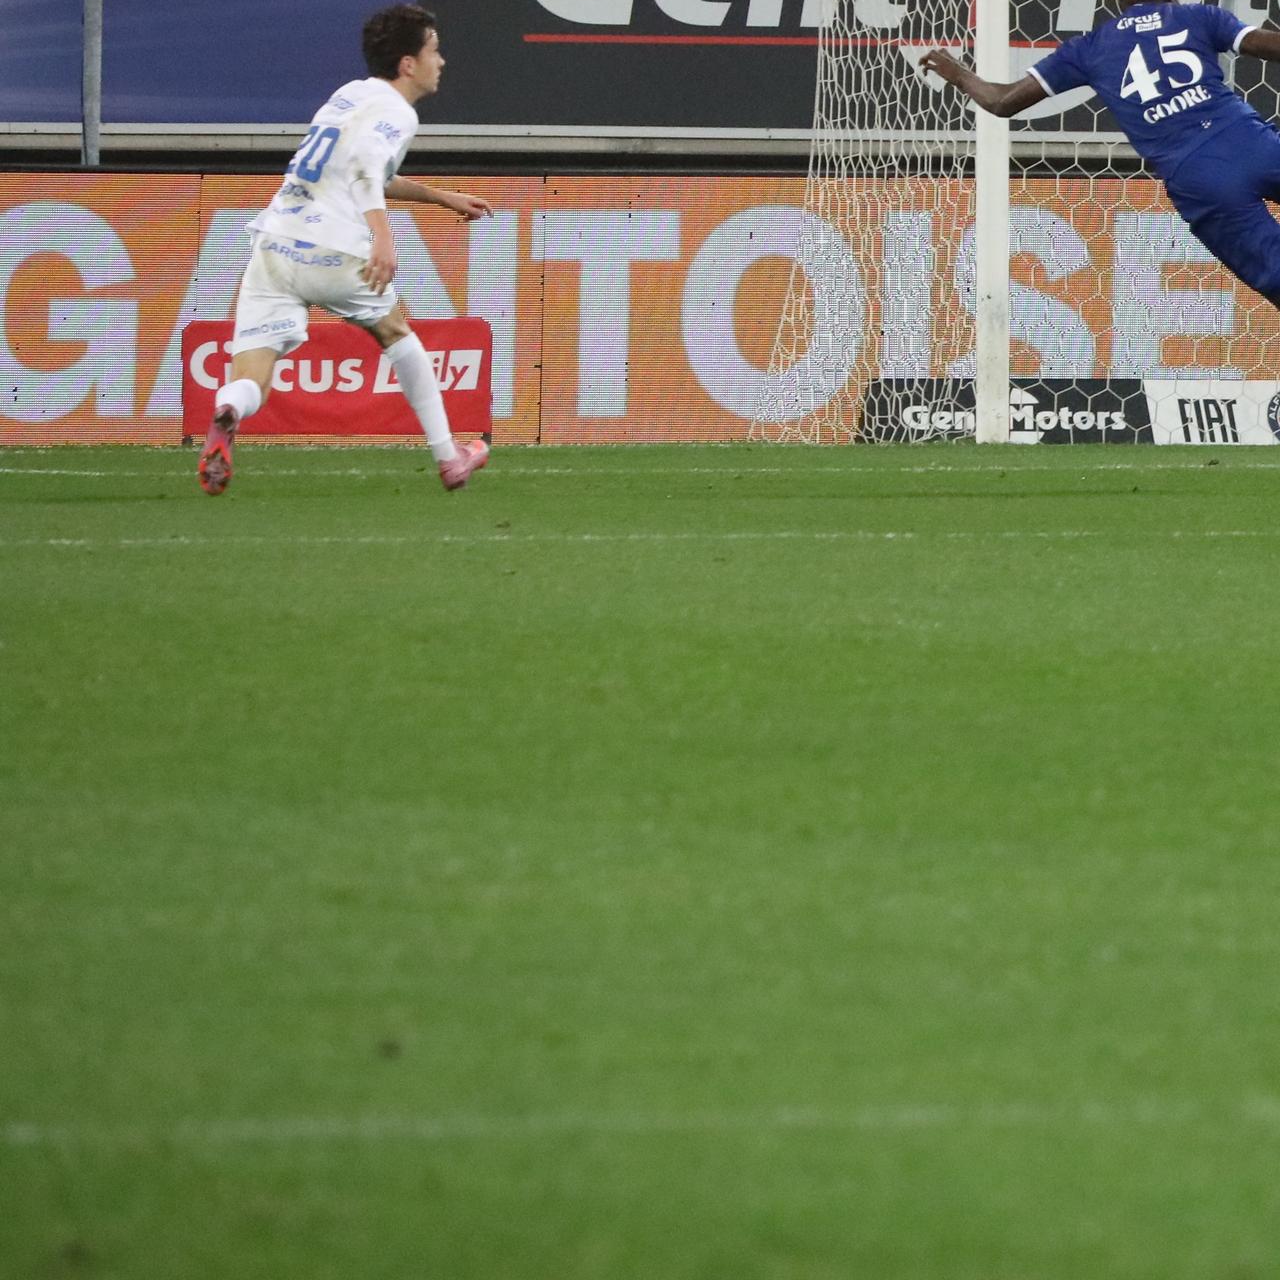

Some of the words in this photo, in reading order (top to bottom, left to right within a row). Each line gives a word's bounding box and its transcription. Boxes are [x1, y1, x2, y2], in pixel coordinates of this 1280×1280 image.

[1120, 28, 1203, 104] 45
[1143, 84, 1212, 124] GOORE
[190, 341, 364, 395] Ccus
[902, 405, 976, 431] Gen
[1009, 404, 1127, 432] Motors
[1177, 398, 1240, 443] FIAT
